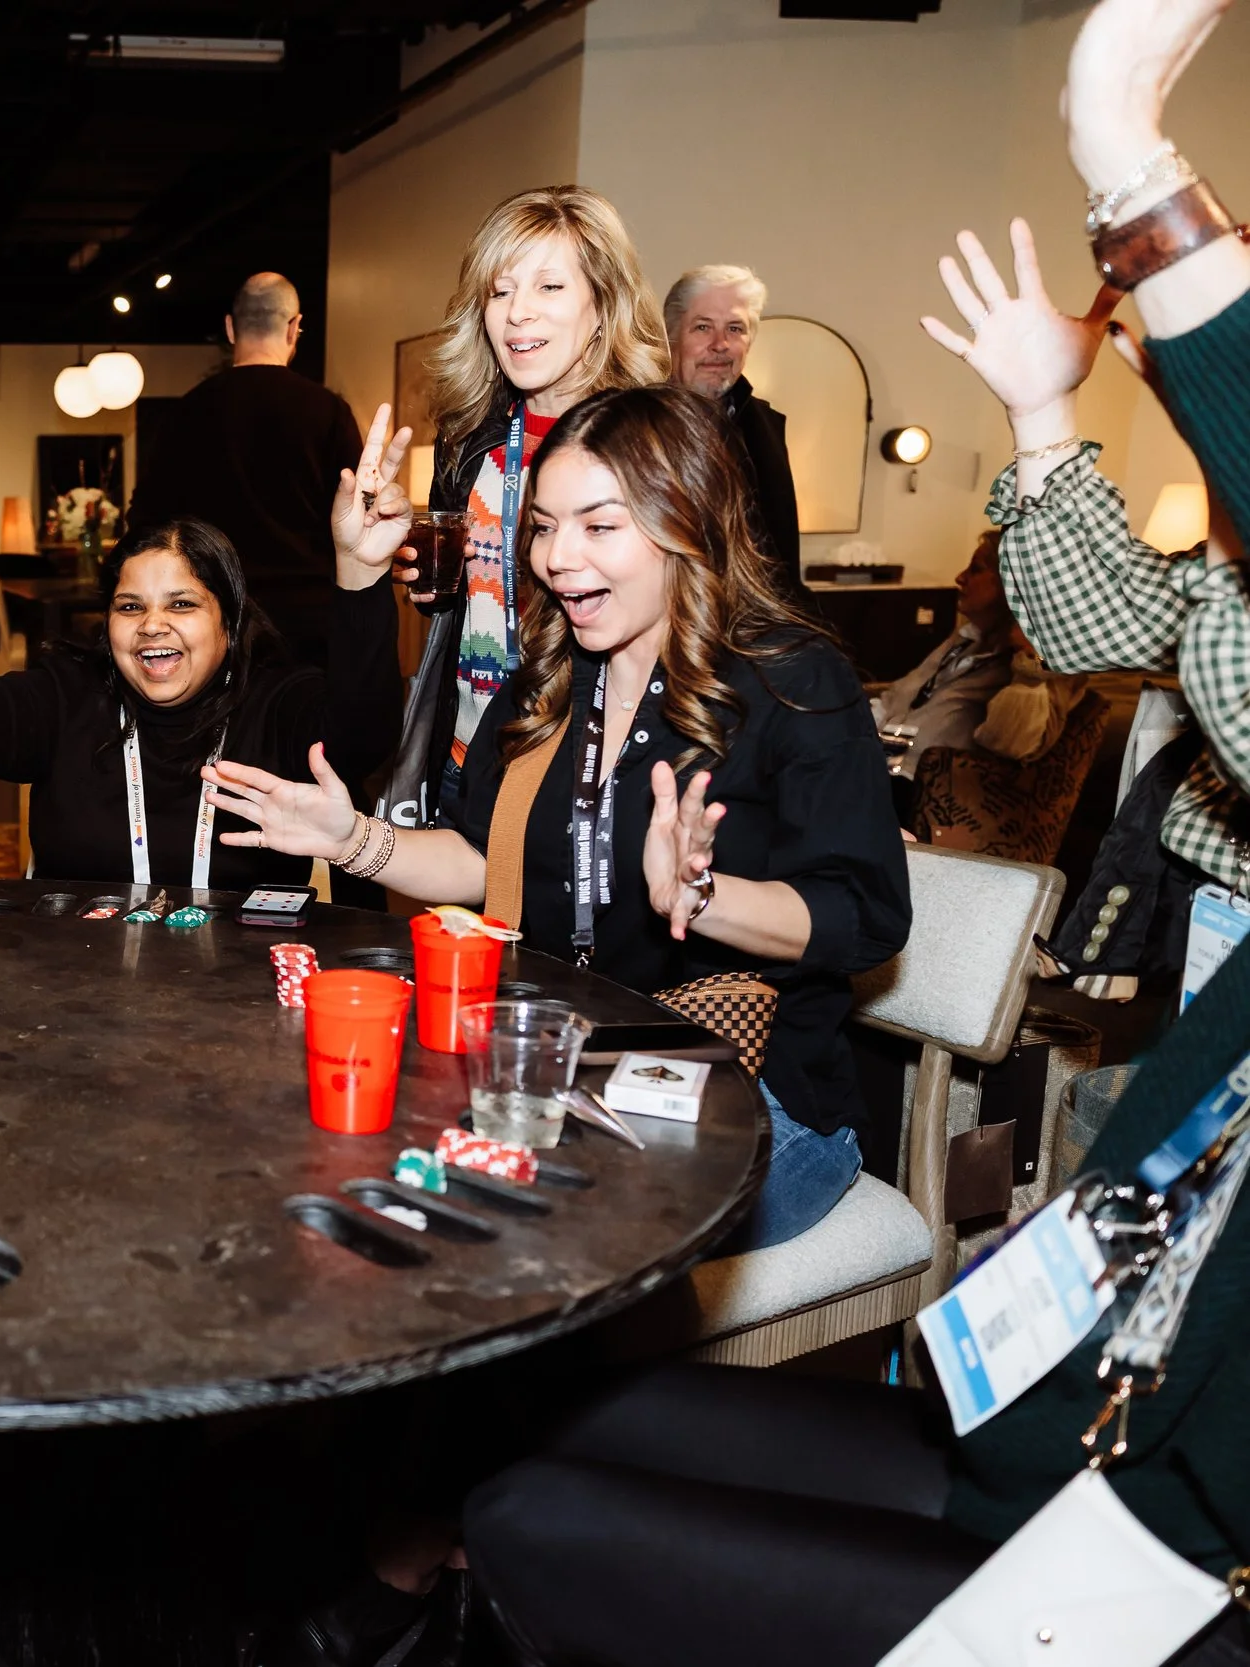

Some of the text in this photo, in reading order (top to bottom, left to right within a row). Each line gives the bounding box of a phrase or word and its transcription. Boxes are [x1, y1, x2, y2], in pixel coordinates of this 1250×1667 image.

[510, 418, 520, 446] B1168
[505, 475, 518, 490] 20
[505, 559, 514, 567] of
[601, 798, 610, 818] Rugs
[200, 818, 208, 826] of
[578, 821, 591, 840] Rugs
[199, 828, 207, 857] America
[578, 842, 590, 879] Weighted
[600, 878, 609, 886] the
